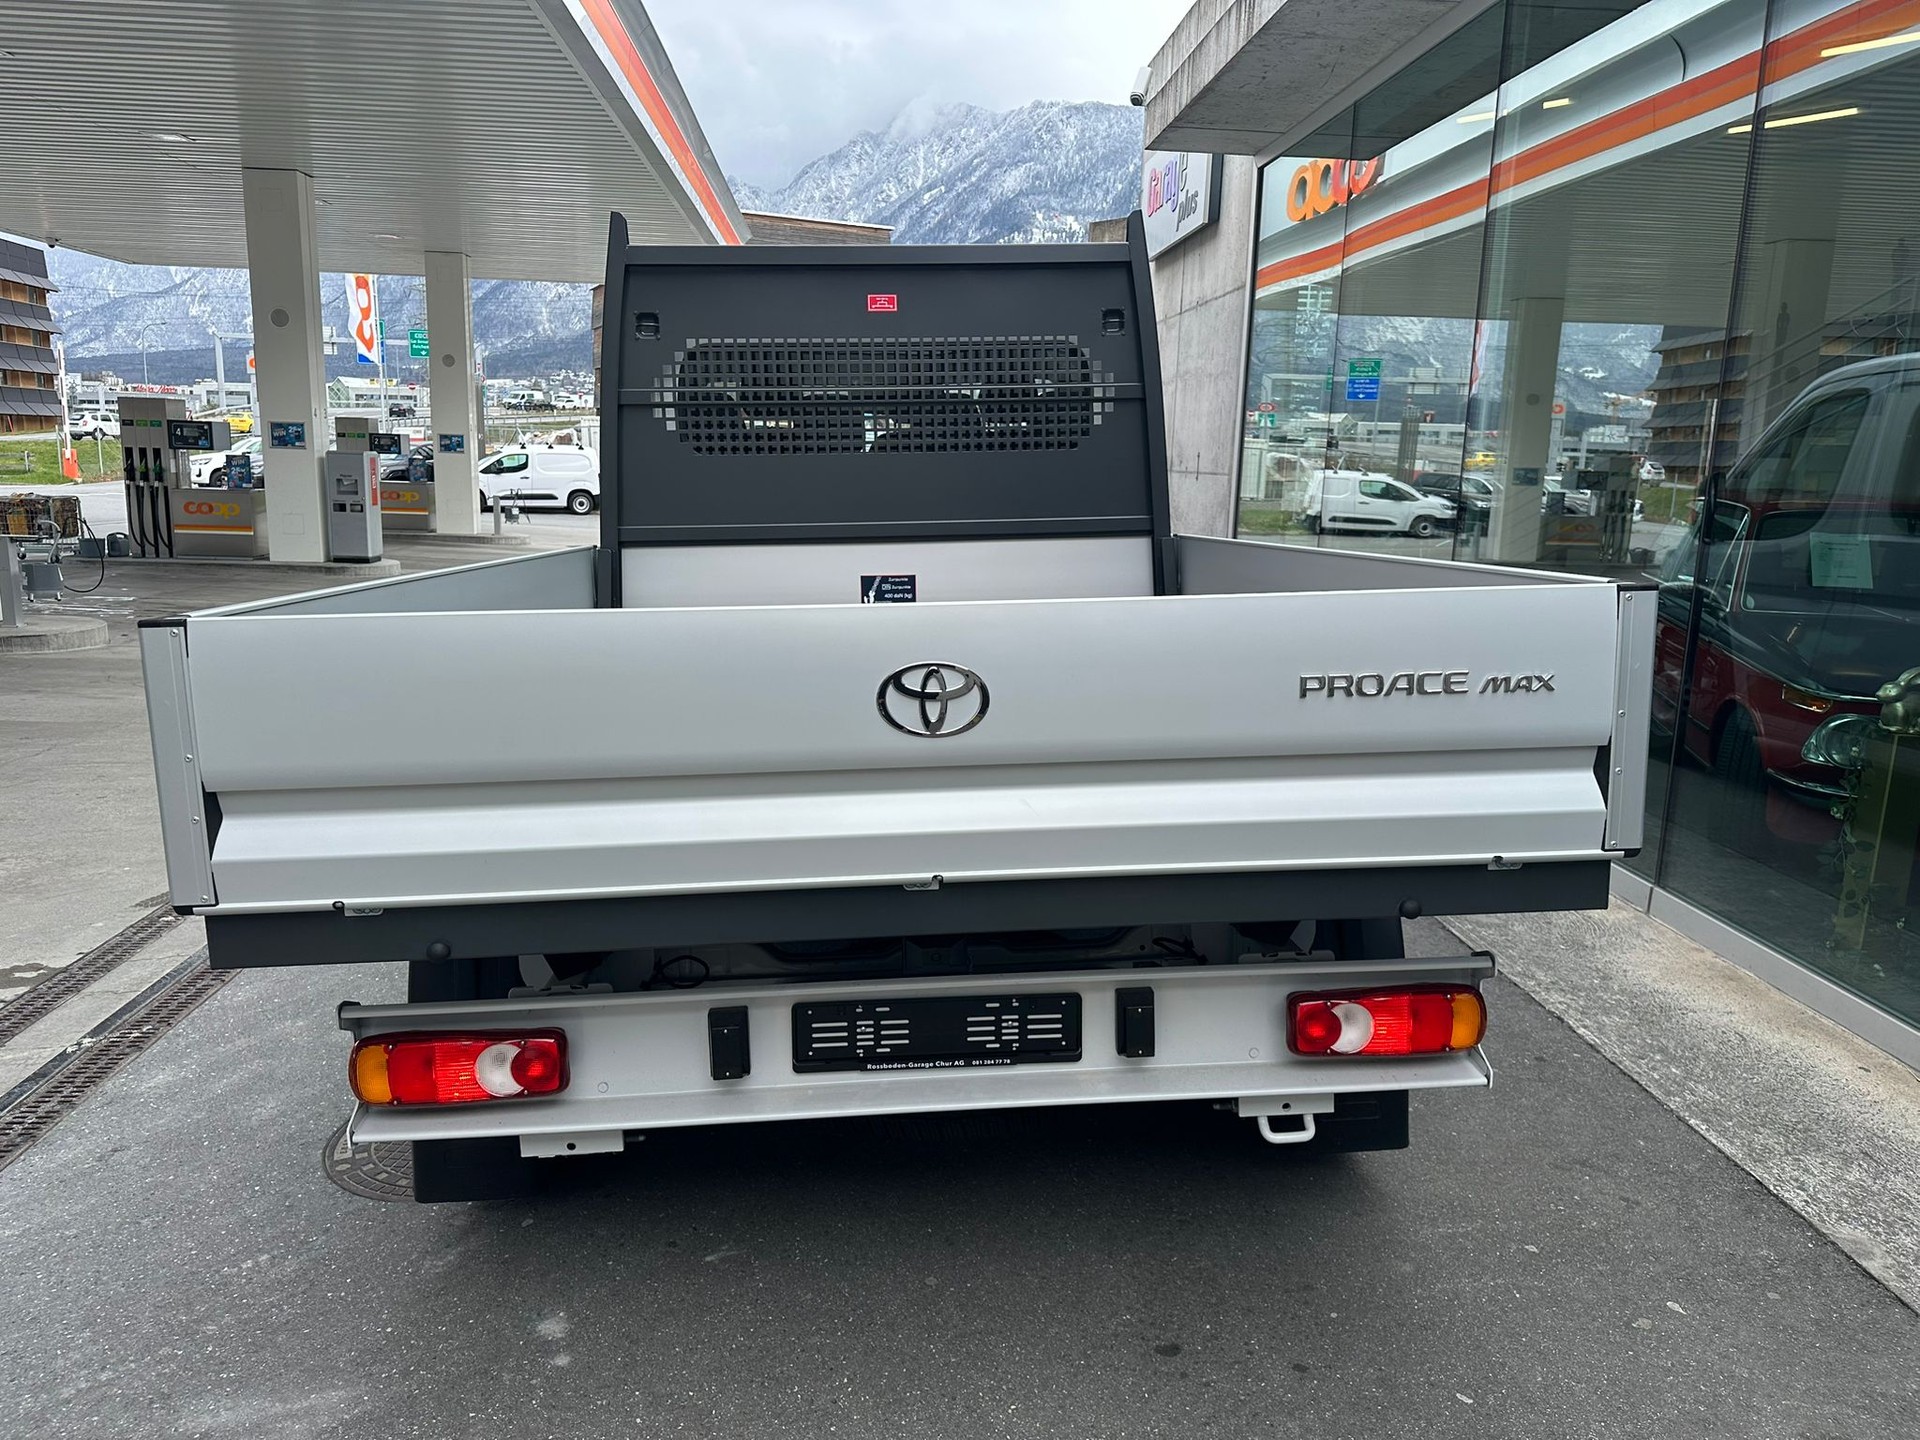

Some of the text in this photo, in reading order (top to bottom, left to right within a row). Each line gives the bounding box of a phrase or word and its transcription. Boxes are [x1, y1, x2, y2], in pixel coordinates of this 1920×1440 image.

[1175, 189, 1199, 232] plus
[175, 428, 181, 437] 4
[182, 501, 241, 519] coop
[1299, 669, 1556, 699] PROACE MAX
[867, 1061, 934, 1070] Rossboden-Garage
